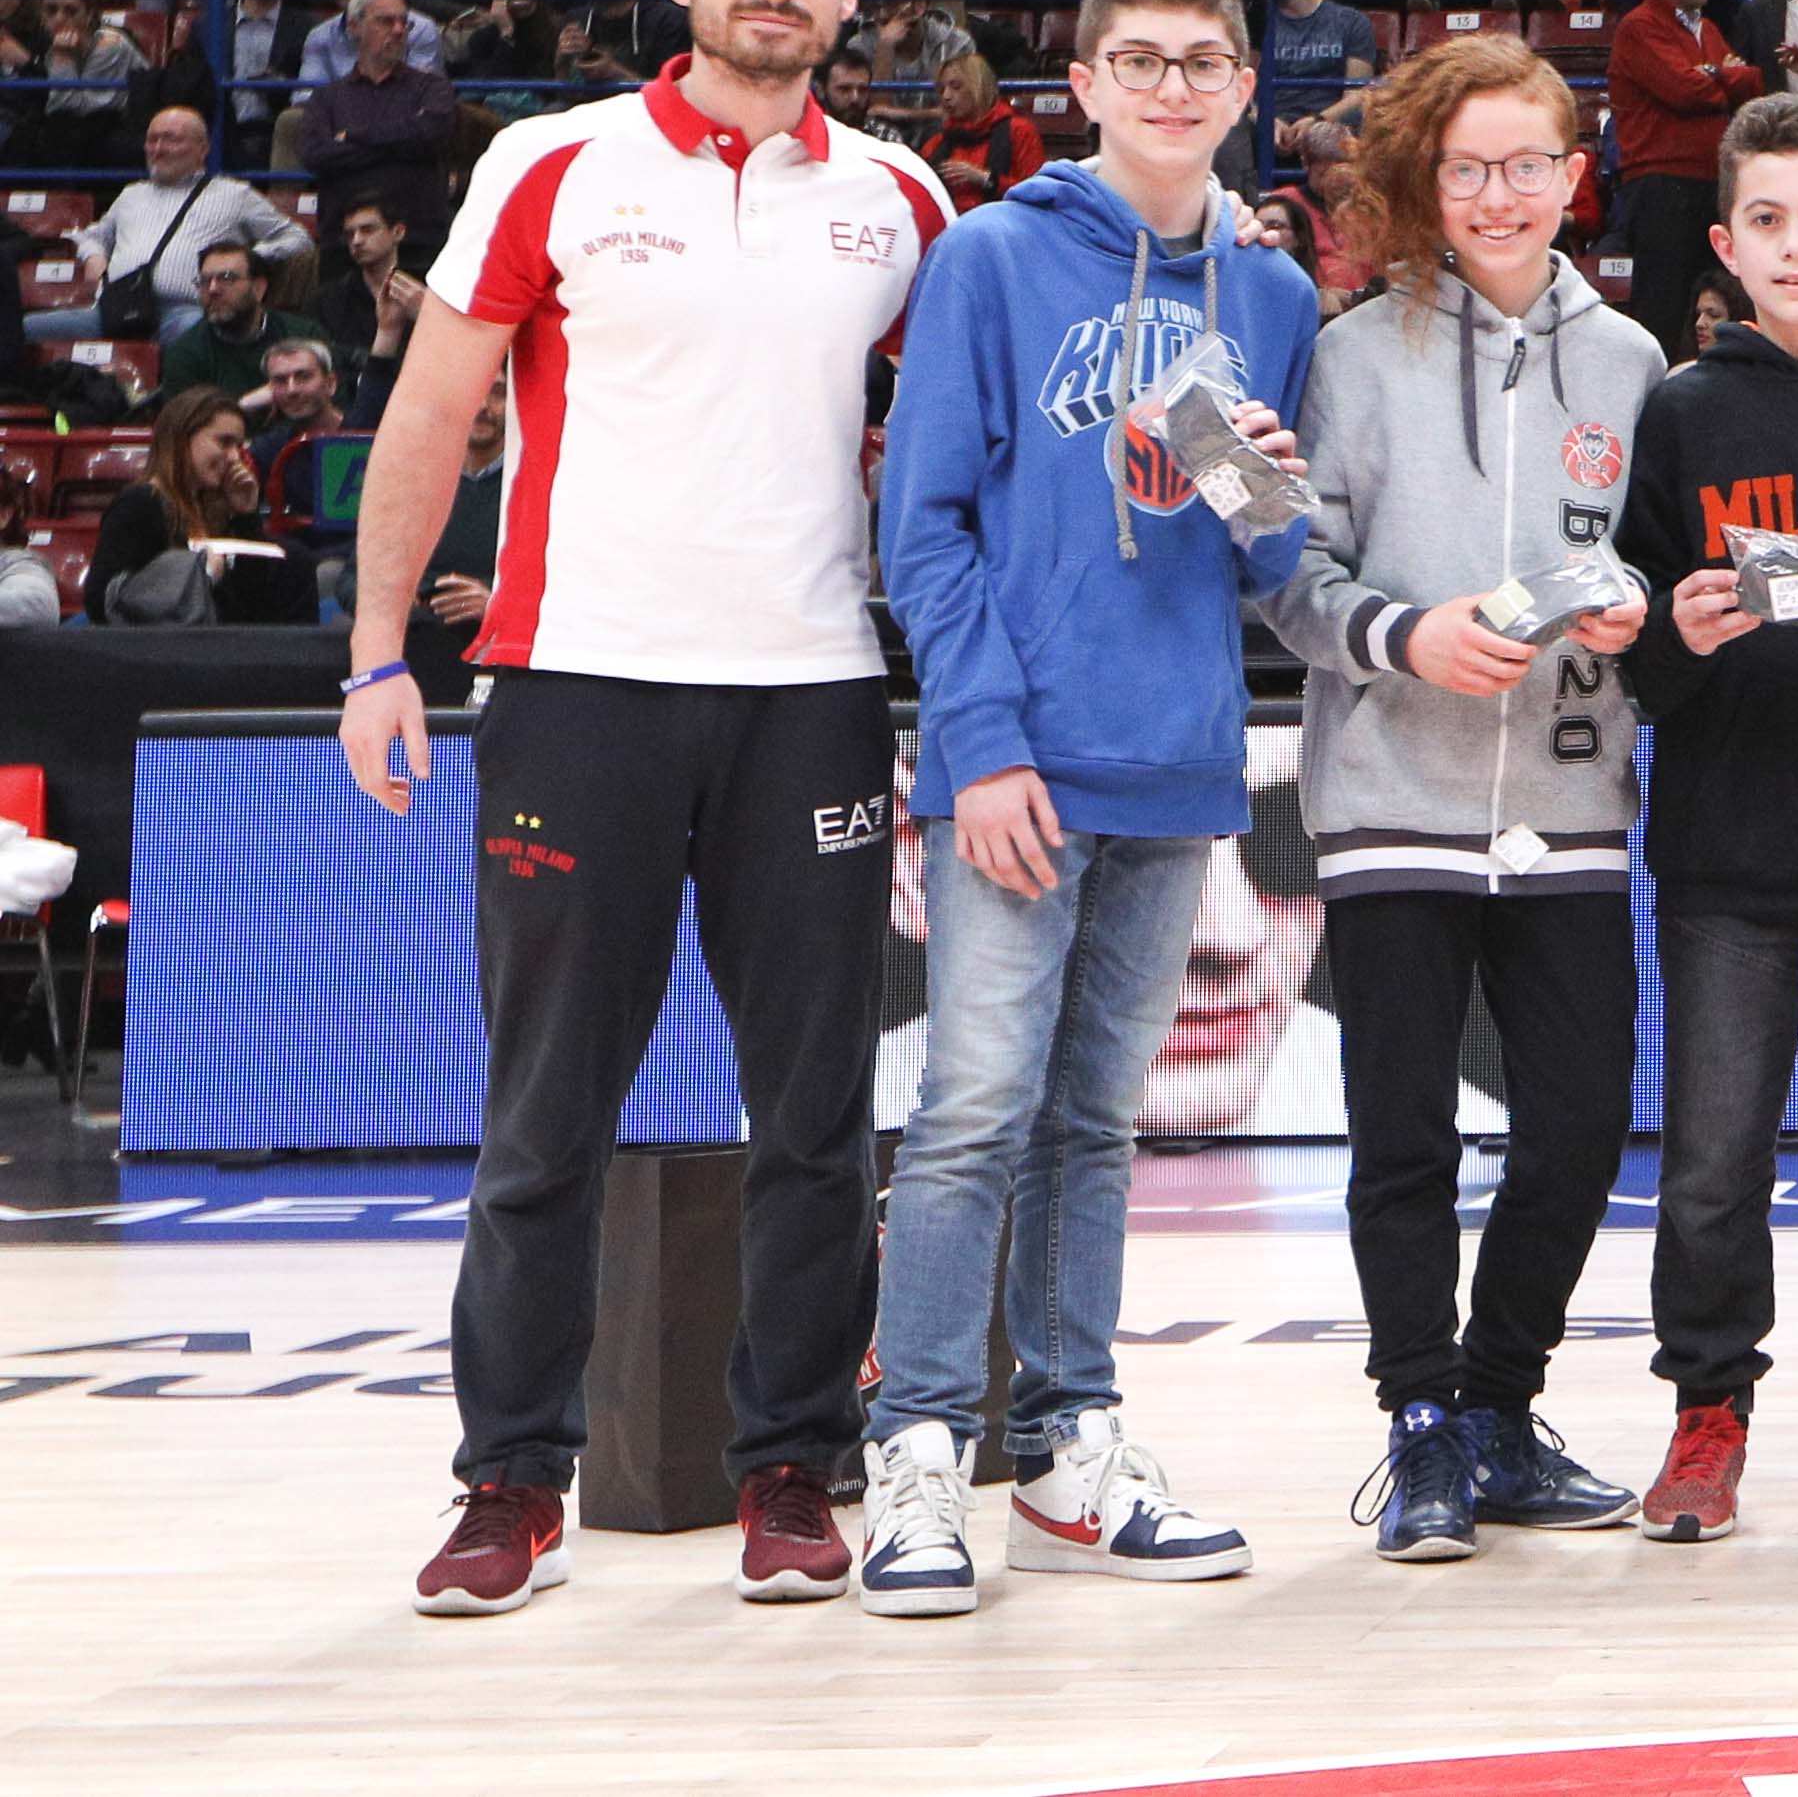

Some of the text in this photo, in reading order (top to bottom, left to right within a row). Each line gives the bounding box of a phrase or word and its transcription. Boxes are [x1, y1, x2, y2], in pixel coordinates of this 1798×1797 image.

[1456, 15, 1470, 28] 13
[1580, 15, 1594, 28] 14
[1274, 44, 1343, 60] CIFICO
[1043, 98, 1058, 113] 10
[581, 232, 687, 257] OLIMPIA MILANO
[829, 222, 898, 258] EA7
[620, 250, 650, 265] 1936
[1610, 261, 1626, 275] 15
[1159, 299, 1204, 327] YORK
[1549, 655, 1605, 765] 2.0
[813, 793, 888, 845] EA7
[485, 836, 578, 874] OLIMPIA MILANO
[509, 857, 539, 878] 1936
